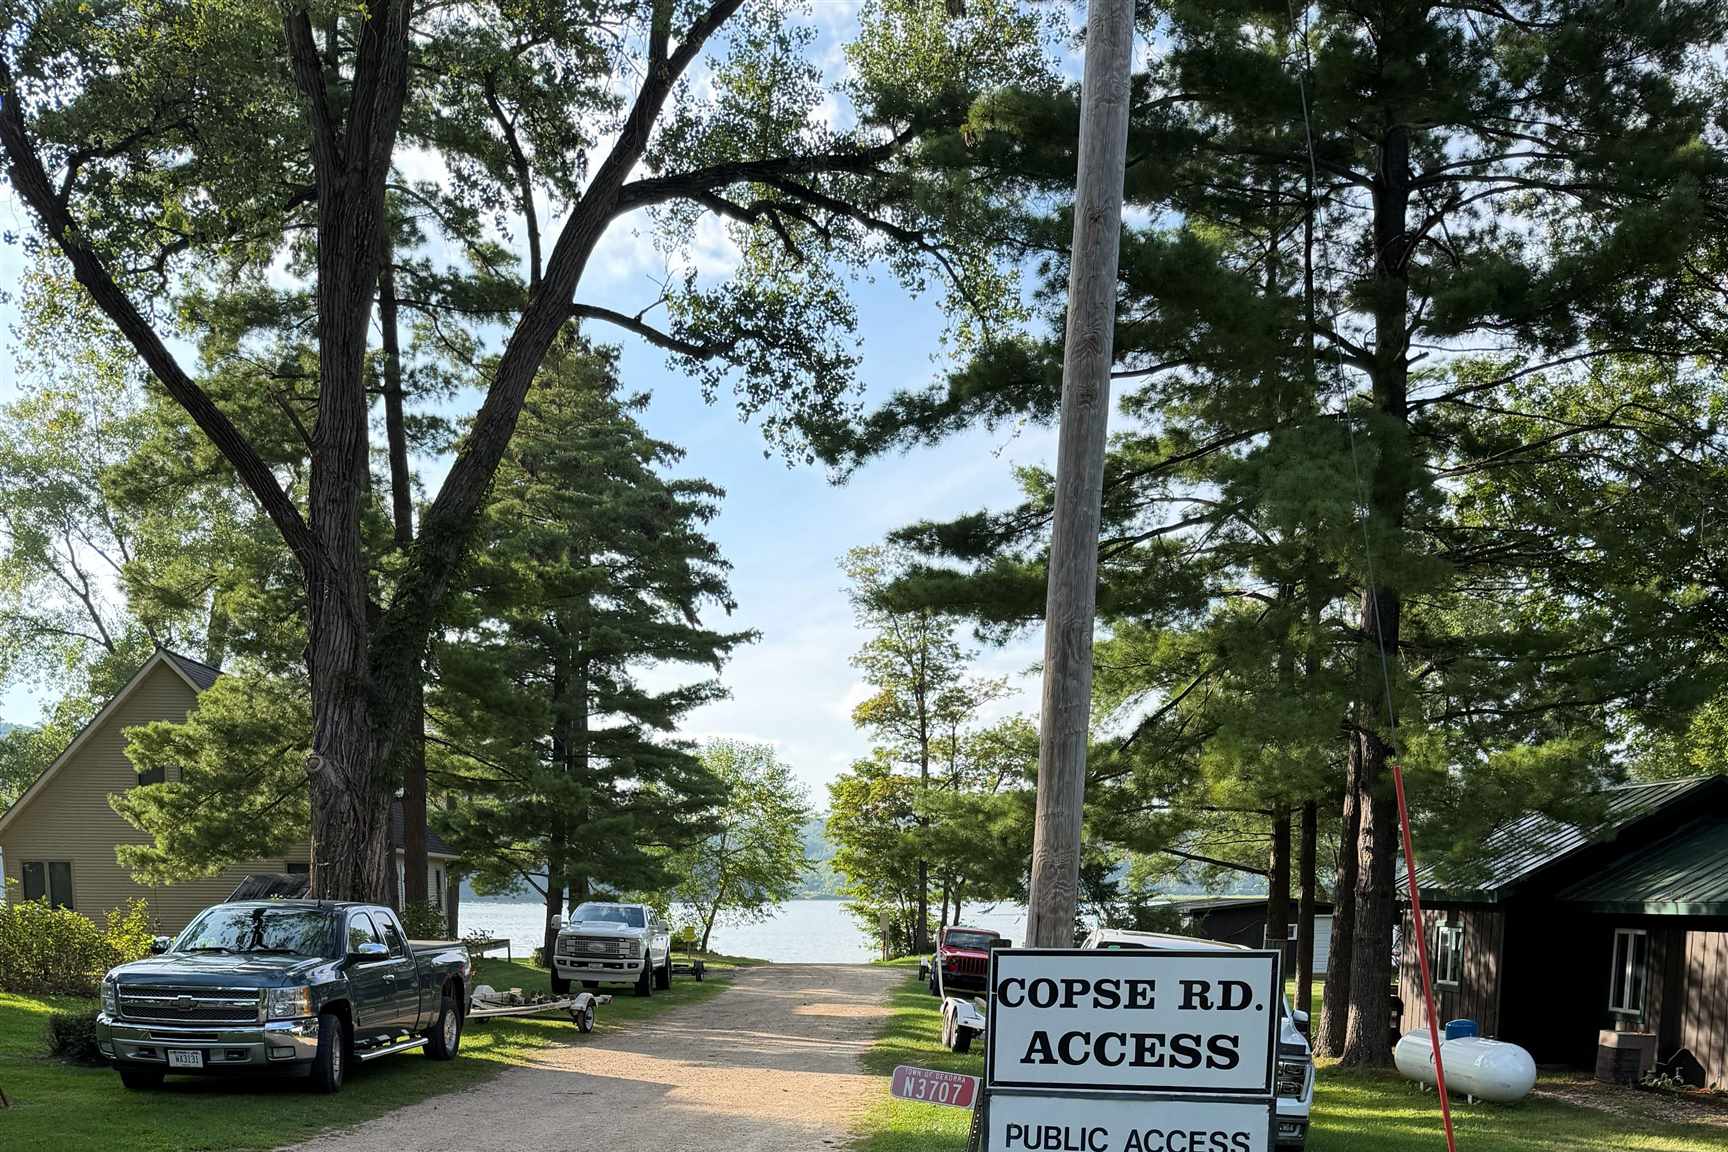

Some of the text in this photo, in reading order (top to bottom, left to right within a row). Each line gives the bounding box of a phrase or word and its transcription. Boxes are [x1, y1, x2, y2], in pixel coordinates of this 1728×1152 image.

[998, 978, 1264, 1011] COPSE RD.
[1020, 1030, 1240, 1070] ACCESS
[902, 1076, 963, 1105] N3707
[1005, 1124, 1109, 1152] PUBLIC
